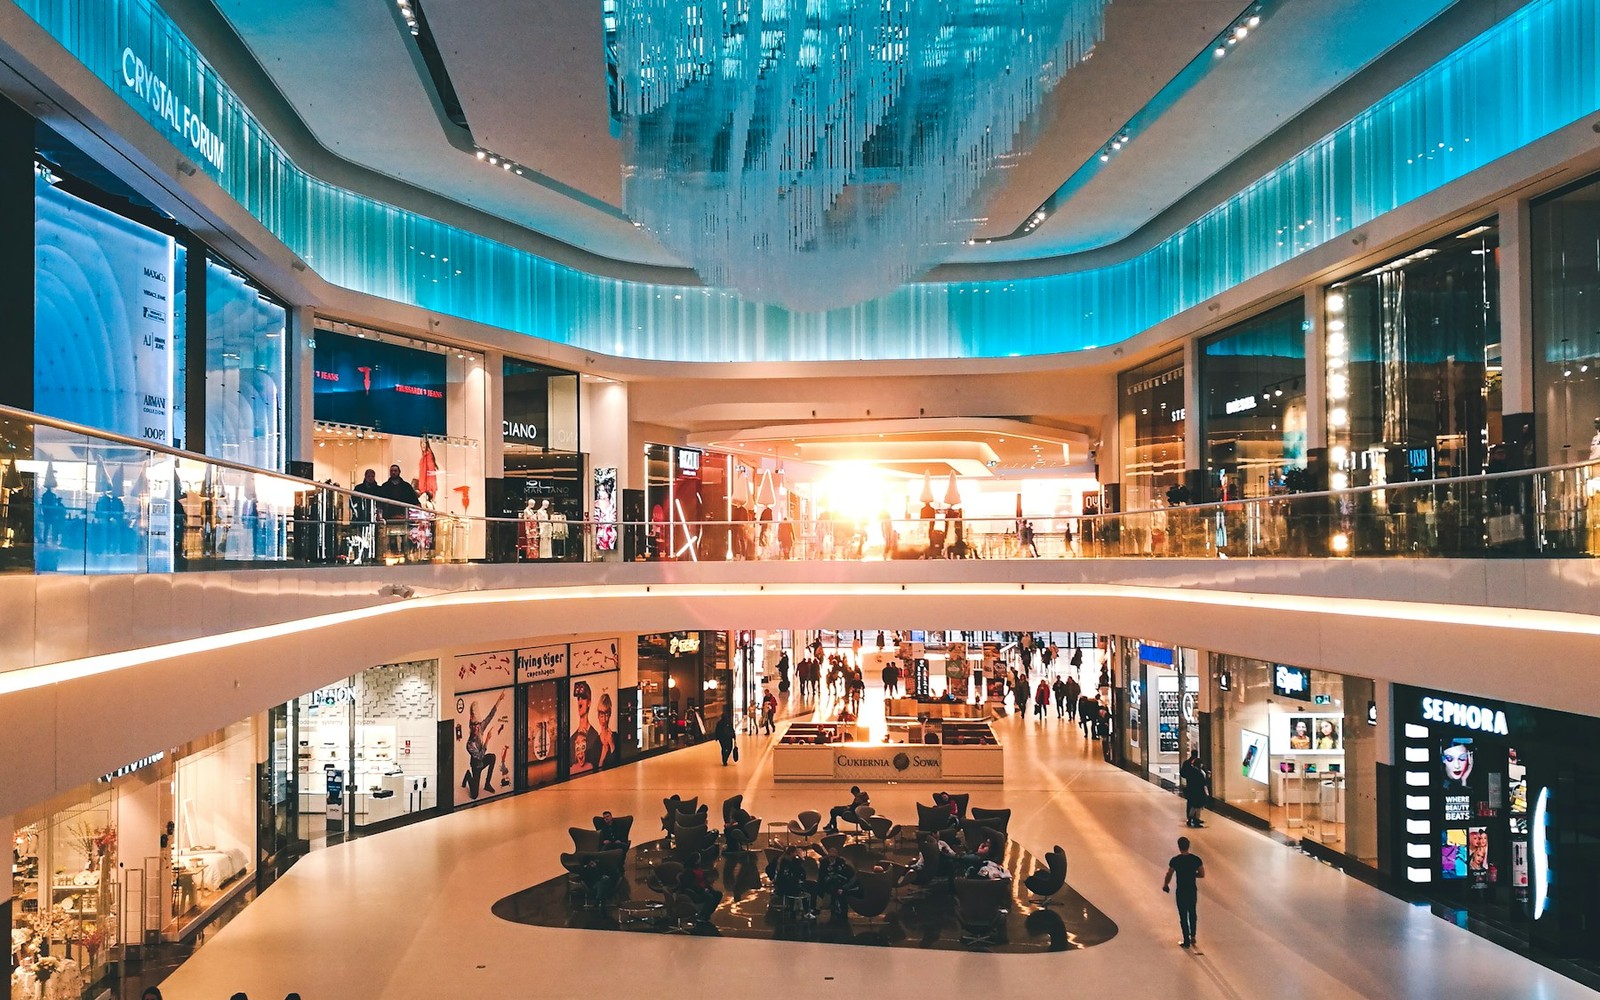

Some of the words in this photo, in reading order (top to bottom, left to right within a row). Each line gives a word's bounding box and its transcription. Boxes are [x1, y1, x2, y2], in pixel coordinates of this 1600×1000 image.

[122, 47, 181, 133] CRYSTAL
[183, 105, 224, 173] FORUM
[143, 426, 166, 441] JOOP!
[518, 653, 542, 671] flying
[542, 652, 564, 668] tiger
[526, 668, 556, 679] copenhagen
[1422, 697, 1509, 736] SEPHORA
[837, 754, 890, 767] CUKIERNIA
[913, 756, 940, 767] SOWA
[1445, 812, 1470, 821] BEATS
